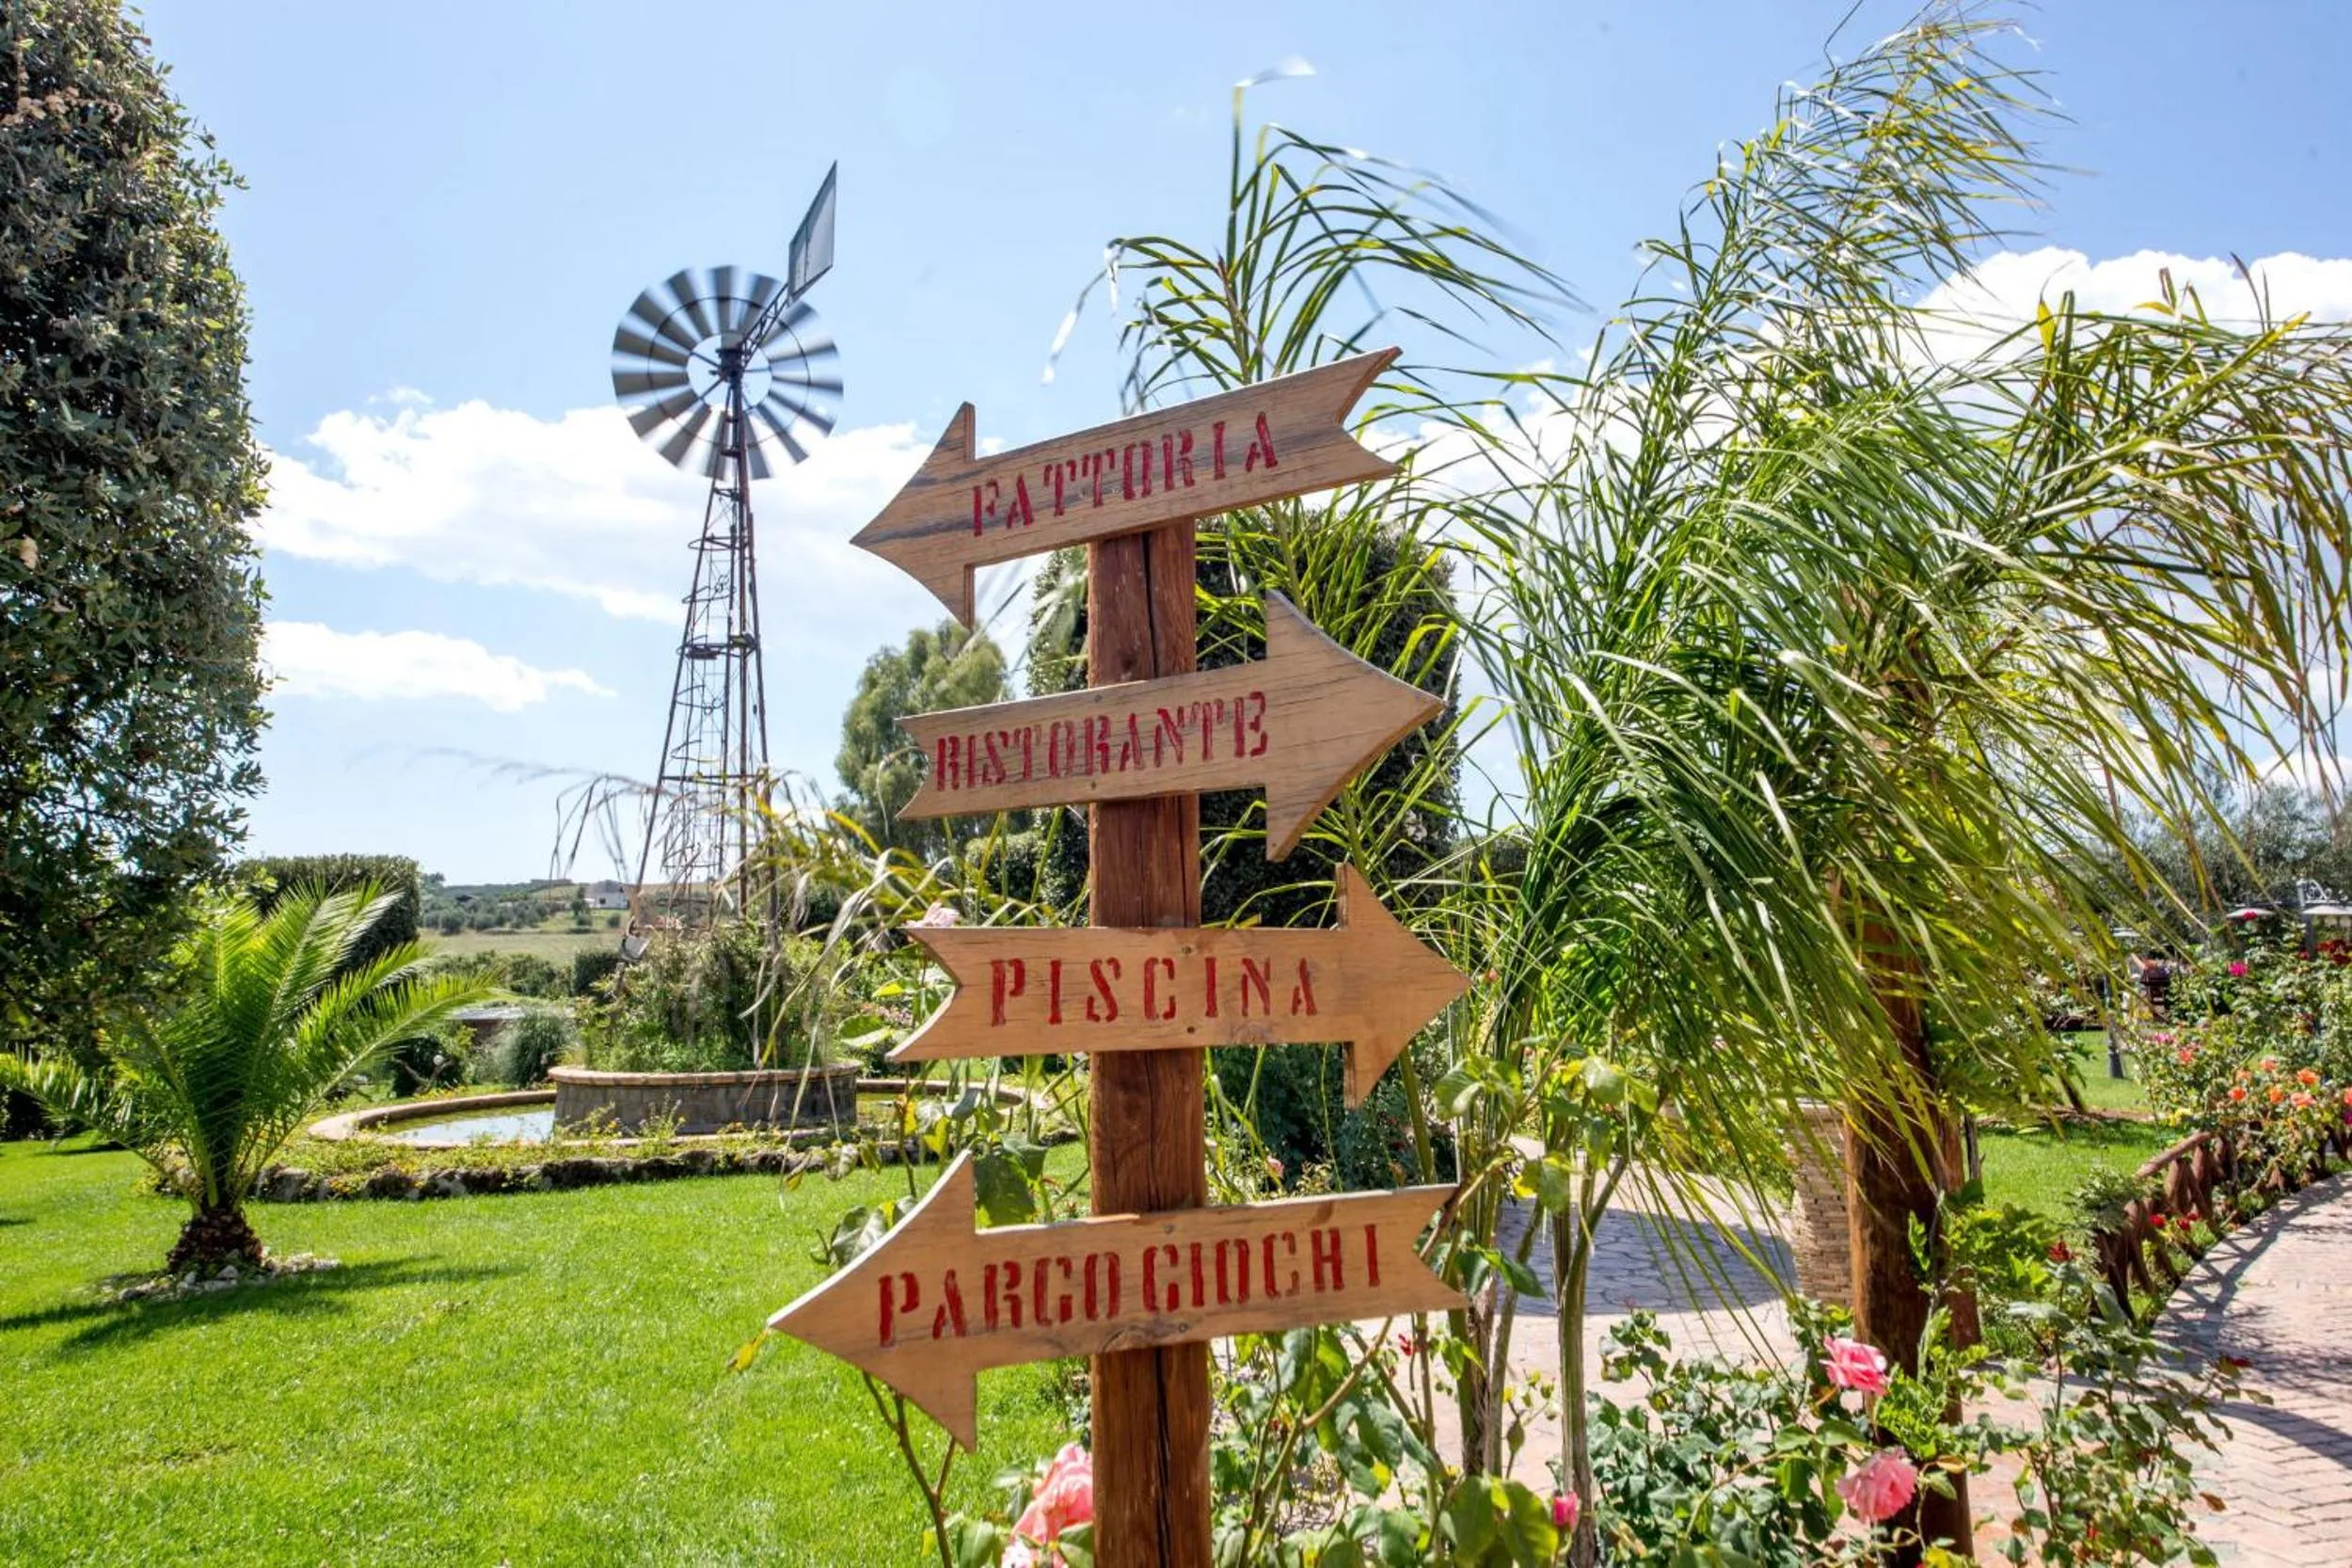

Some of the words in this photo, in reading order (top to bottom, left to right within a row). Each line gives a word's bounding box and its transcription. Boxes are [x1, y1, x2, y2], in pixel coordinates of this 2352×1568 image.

[971, 412, 1279, 537] FATTORIA
[935, 690, 1268, 791] RISTORANTE
[990, 957, 1318, 1027] PISCINA
